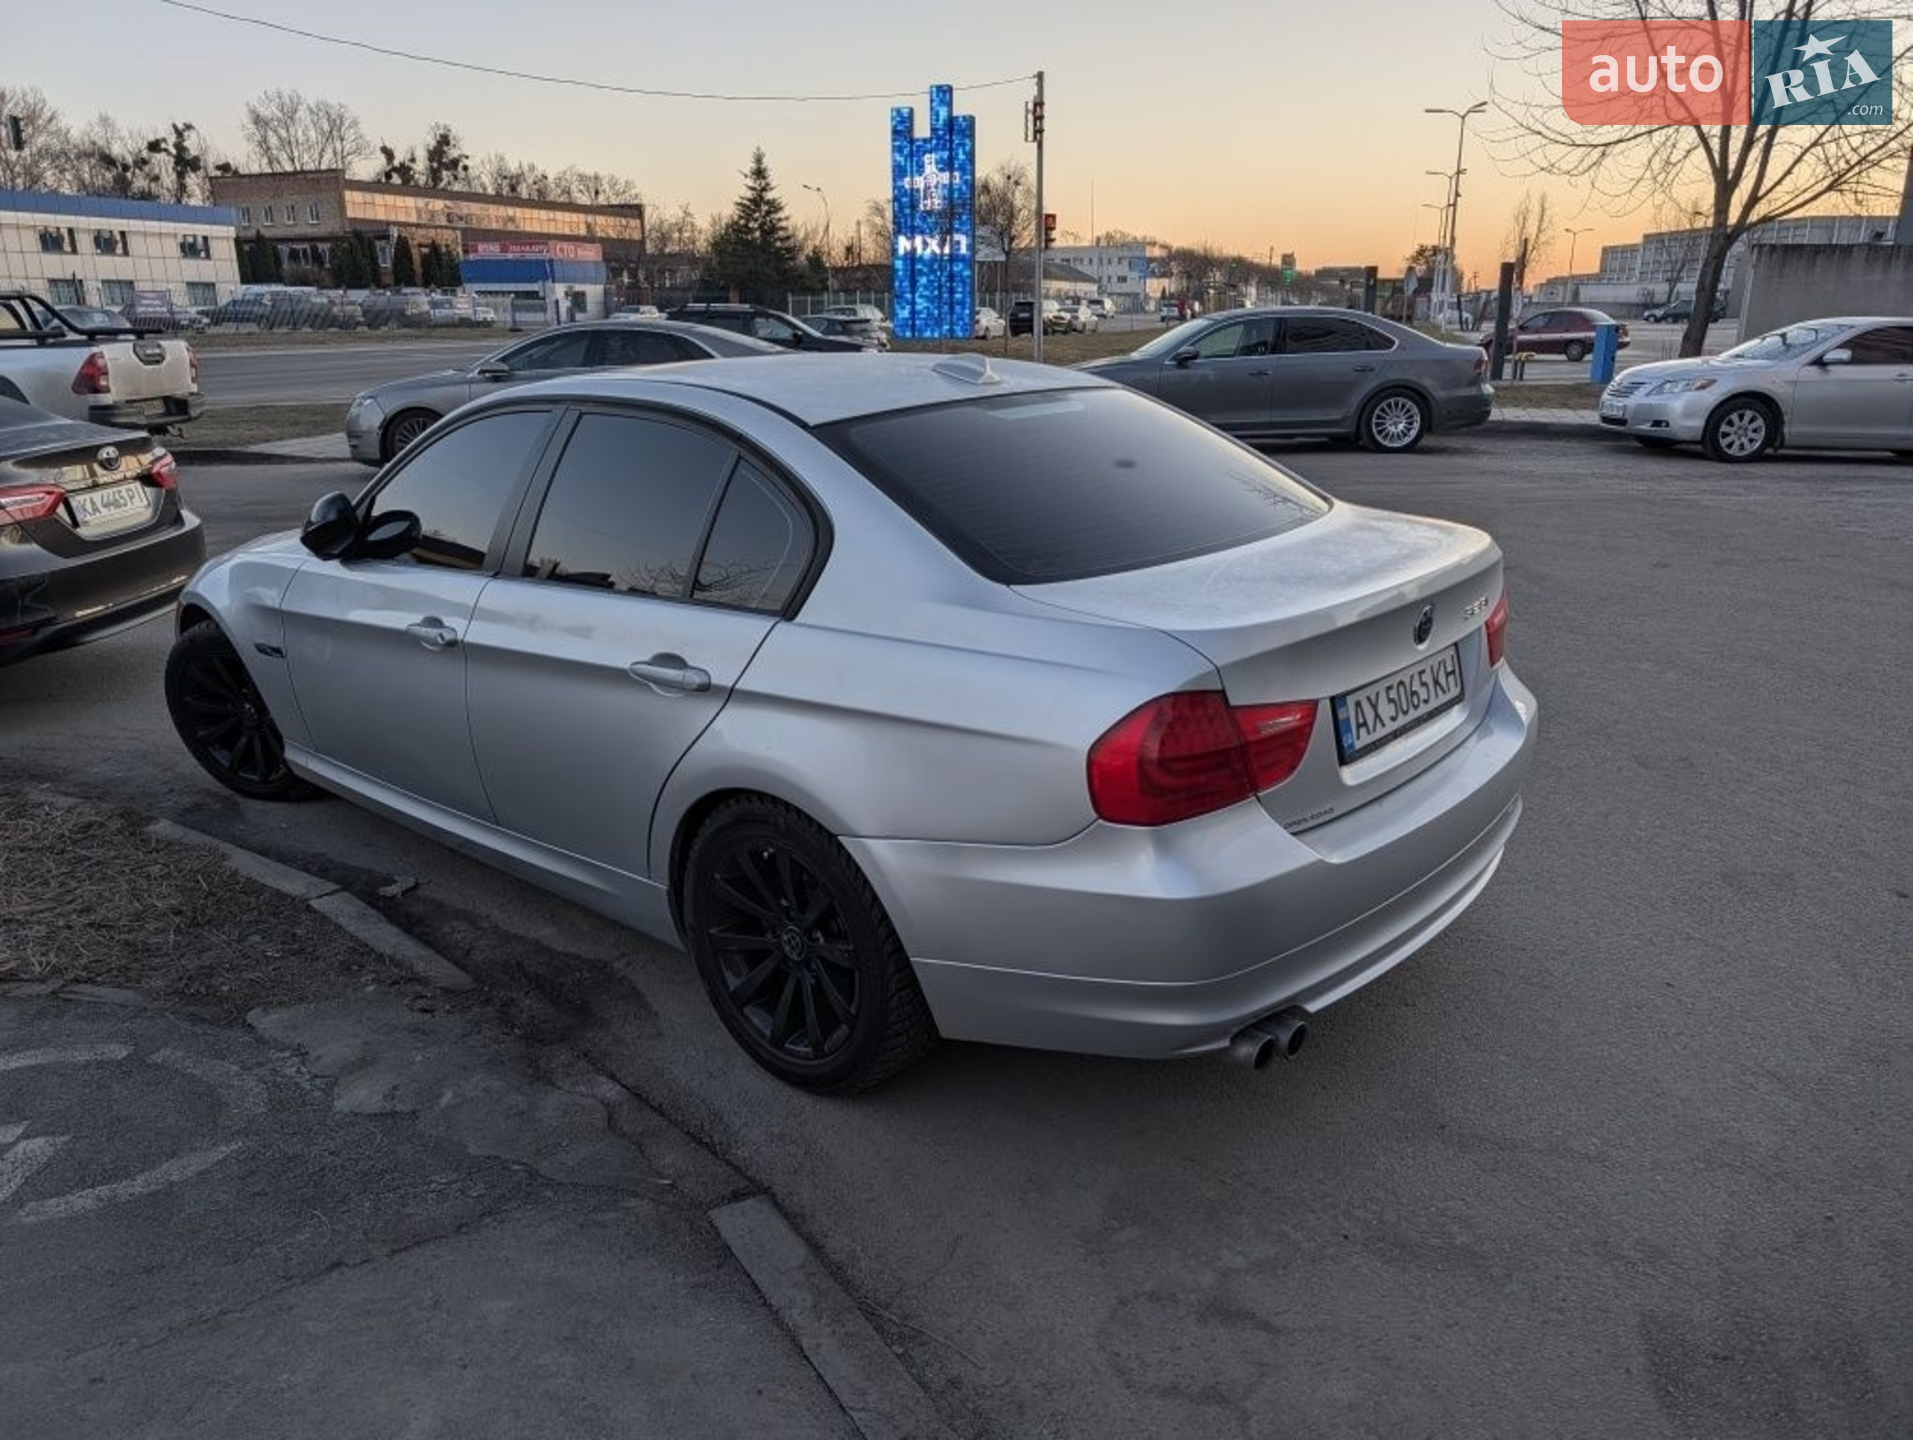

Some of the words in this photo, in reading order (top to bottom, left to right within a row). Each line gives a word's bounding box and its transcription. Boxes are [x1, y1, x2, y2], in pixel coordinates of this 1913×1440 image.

[1354, 691, 1386, 741] AX
[1384, 668, 1431, 722] 5065
[1430, 654, 1459, 699] KH
